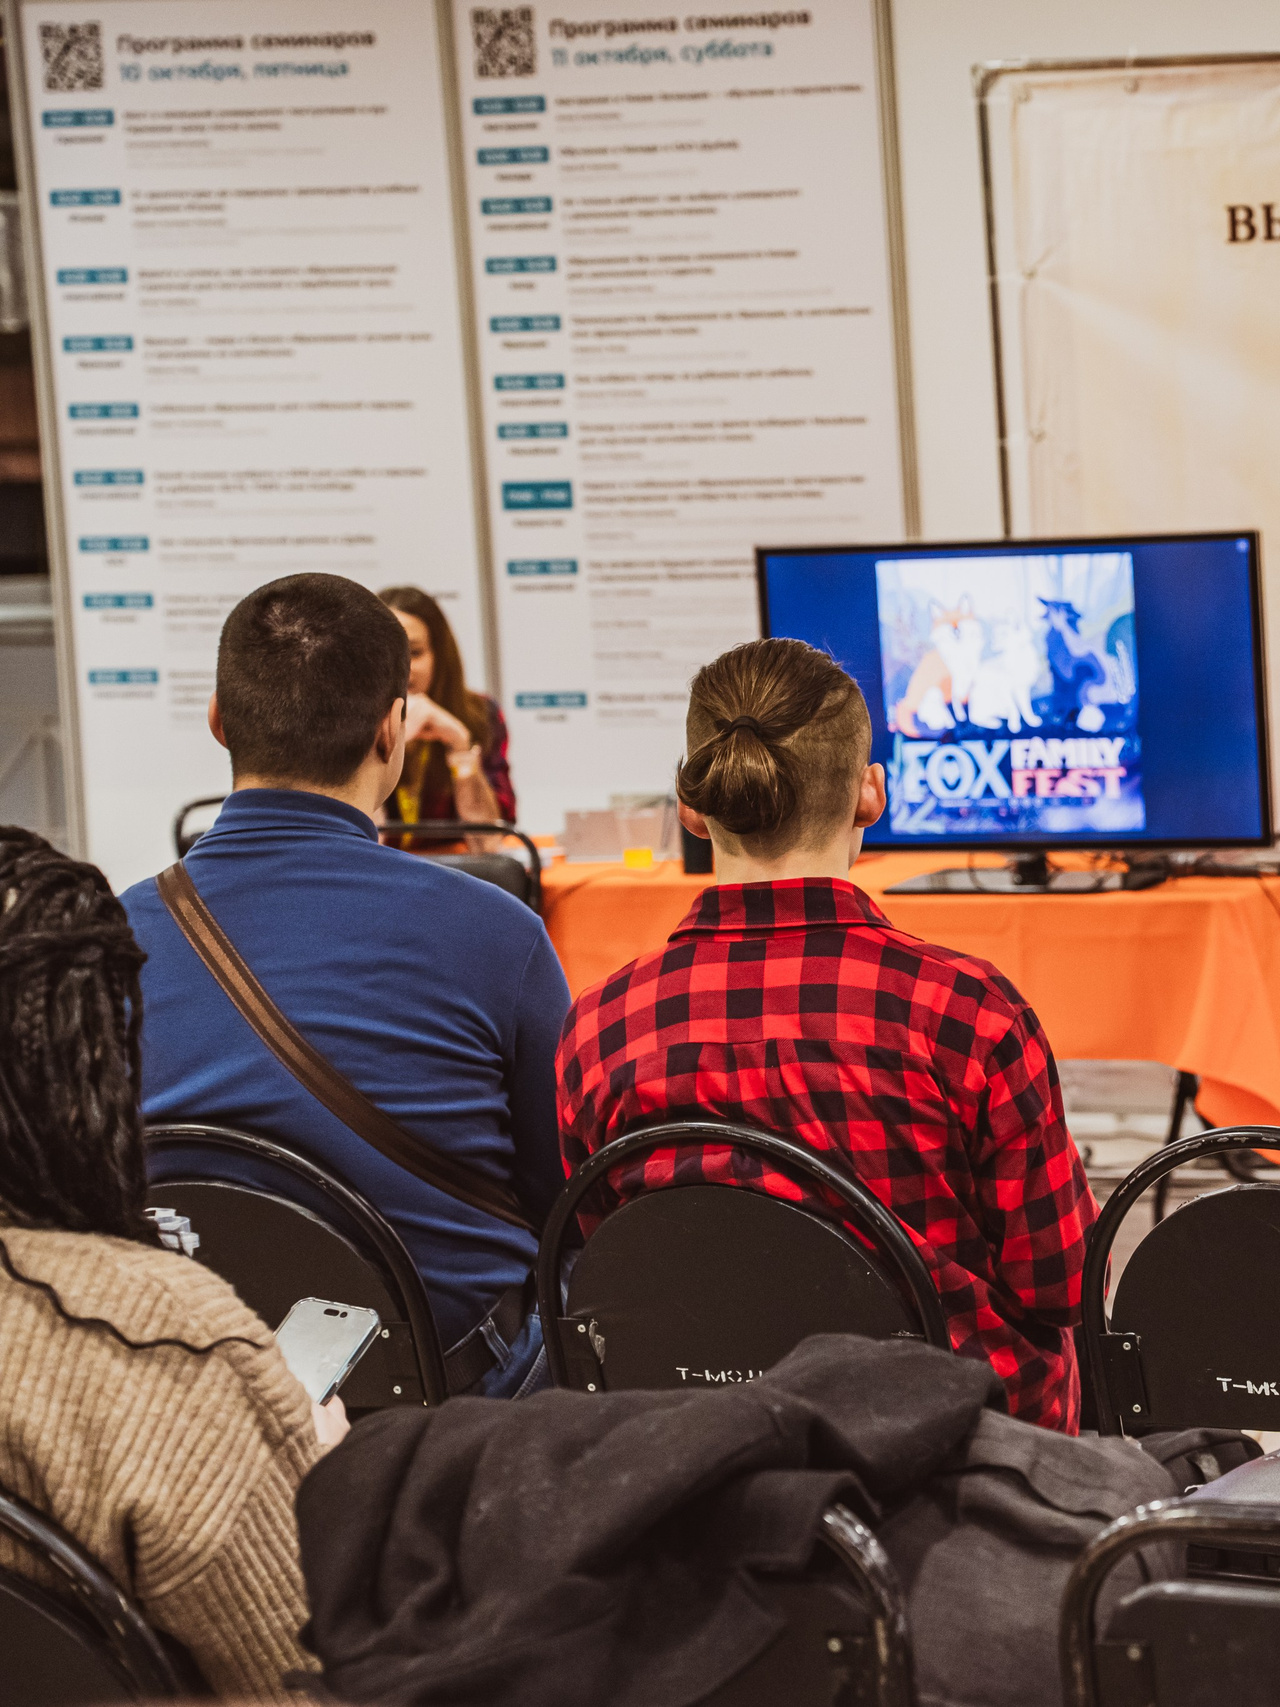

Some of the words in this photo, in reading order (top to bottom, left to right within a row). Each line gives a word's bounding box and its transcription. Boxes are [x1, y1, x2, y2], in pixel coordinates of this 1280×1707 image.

[548, 17, 678, 40] Программа
[683, 9, 812, 31] семинаров
[116, 33, 245, 55] Программа
[250, 30, 377, 51] семинаров
[1010, 735, 1127, 770] FAMILY
[901, 740, 1013, 803] FOX
[1012, 767, 1128, 799] FEST
